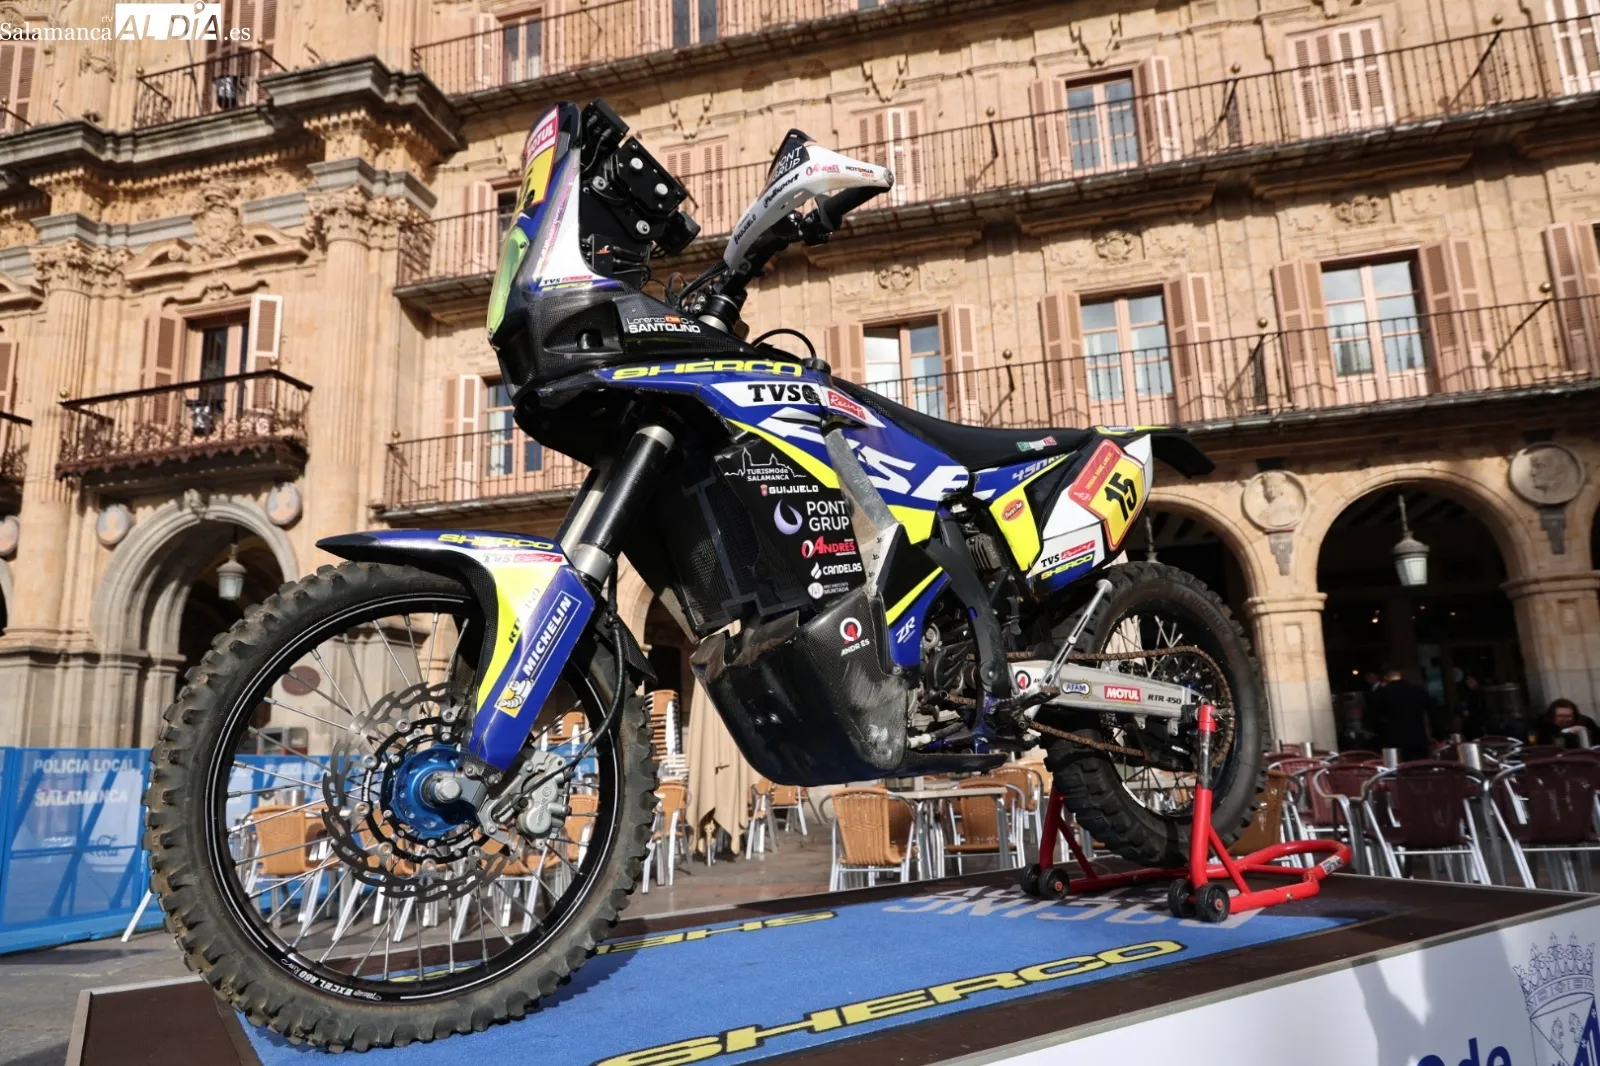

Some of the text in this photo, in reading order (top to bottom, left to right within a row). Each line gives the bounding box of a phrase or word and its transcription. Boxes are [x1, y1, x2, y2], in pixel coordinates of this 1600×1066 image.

[530, 122, 554, 153] OTUL
[626, 317, 666, 325] Lorenzo
[628, 323, 701, 334] SANTOLINO
[612, 359, 803, 380] SHERCO
[747, 384, 802, 402] TVS
[747, 474, 790, 482] SALAMANCA
[768, 485, 819, 495] GUIJUELO
[1104, 472, 1137, 522] 15
[806, 500, 847, 516] PONT
[808, 516, 850, 532] GRUP
[1041, 553, 1061, 568] TVS
[1041, 553, 1094, 581] SHERCO
[822, 562, 863, 576] CANDELAS
[523, 595, 573, 677] MICHELIN
[1066, 682, 1088, 693] AFAM
[1105, 686, 1140, 701] MOTUL
[1147, 692, 1182, 706] RTR 450
[94, 757, 134, 773] LOCAL
[35, 788, 129, 807] SALAMANCA
[299, 970, 320, 985] A60
[319, 979, 353, 996] EXCEL
[590, 938, 1188, 1066] SHERCO
